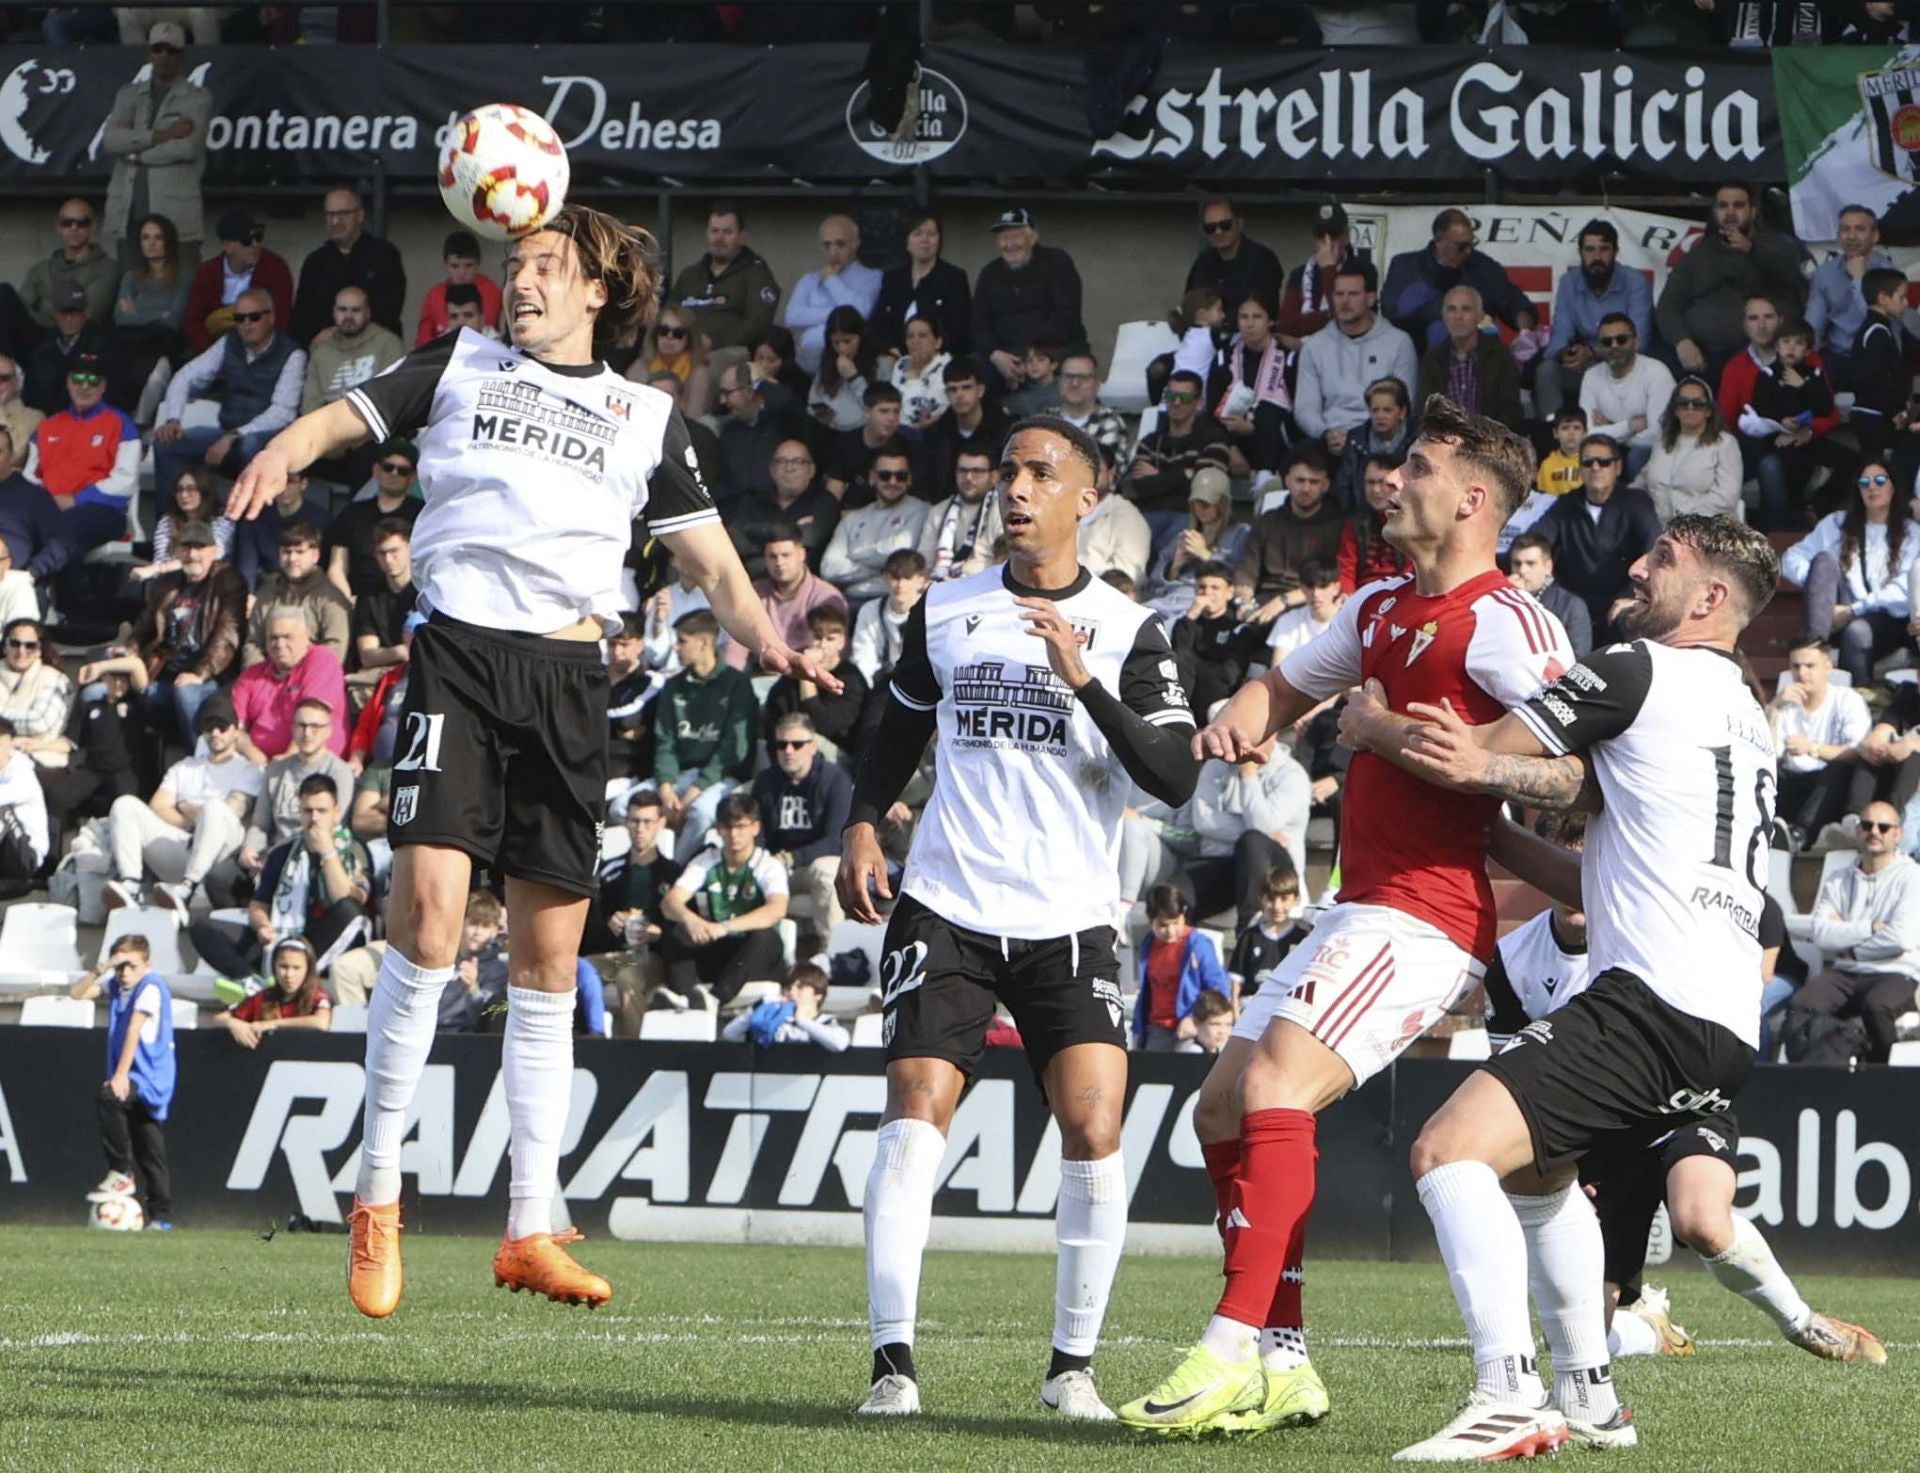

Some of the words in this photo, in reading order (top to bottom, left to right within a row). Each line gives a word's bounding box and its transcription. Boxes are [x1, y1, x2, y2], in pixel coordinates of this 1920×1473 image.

[542, 75, 722, 150] Dehesa
[1451, 62, 1766, 162] Galicia
[394, 711, 445, 772] 21
[956, 706, 1067, 746] MÉRIDA
[882, 940, 928, 1008] 22
